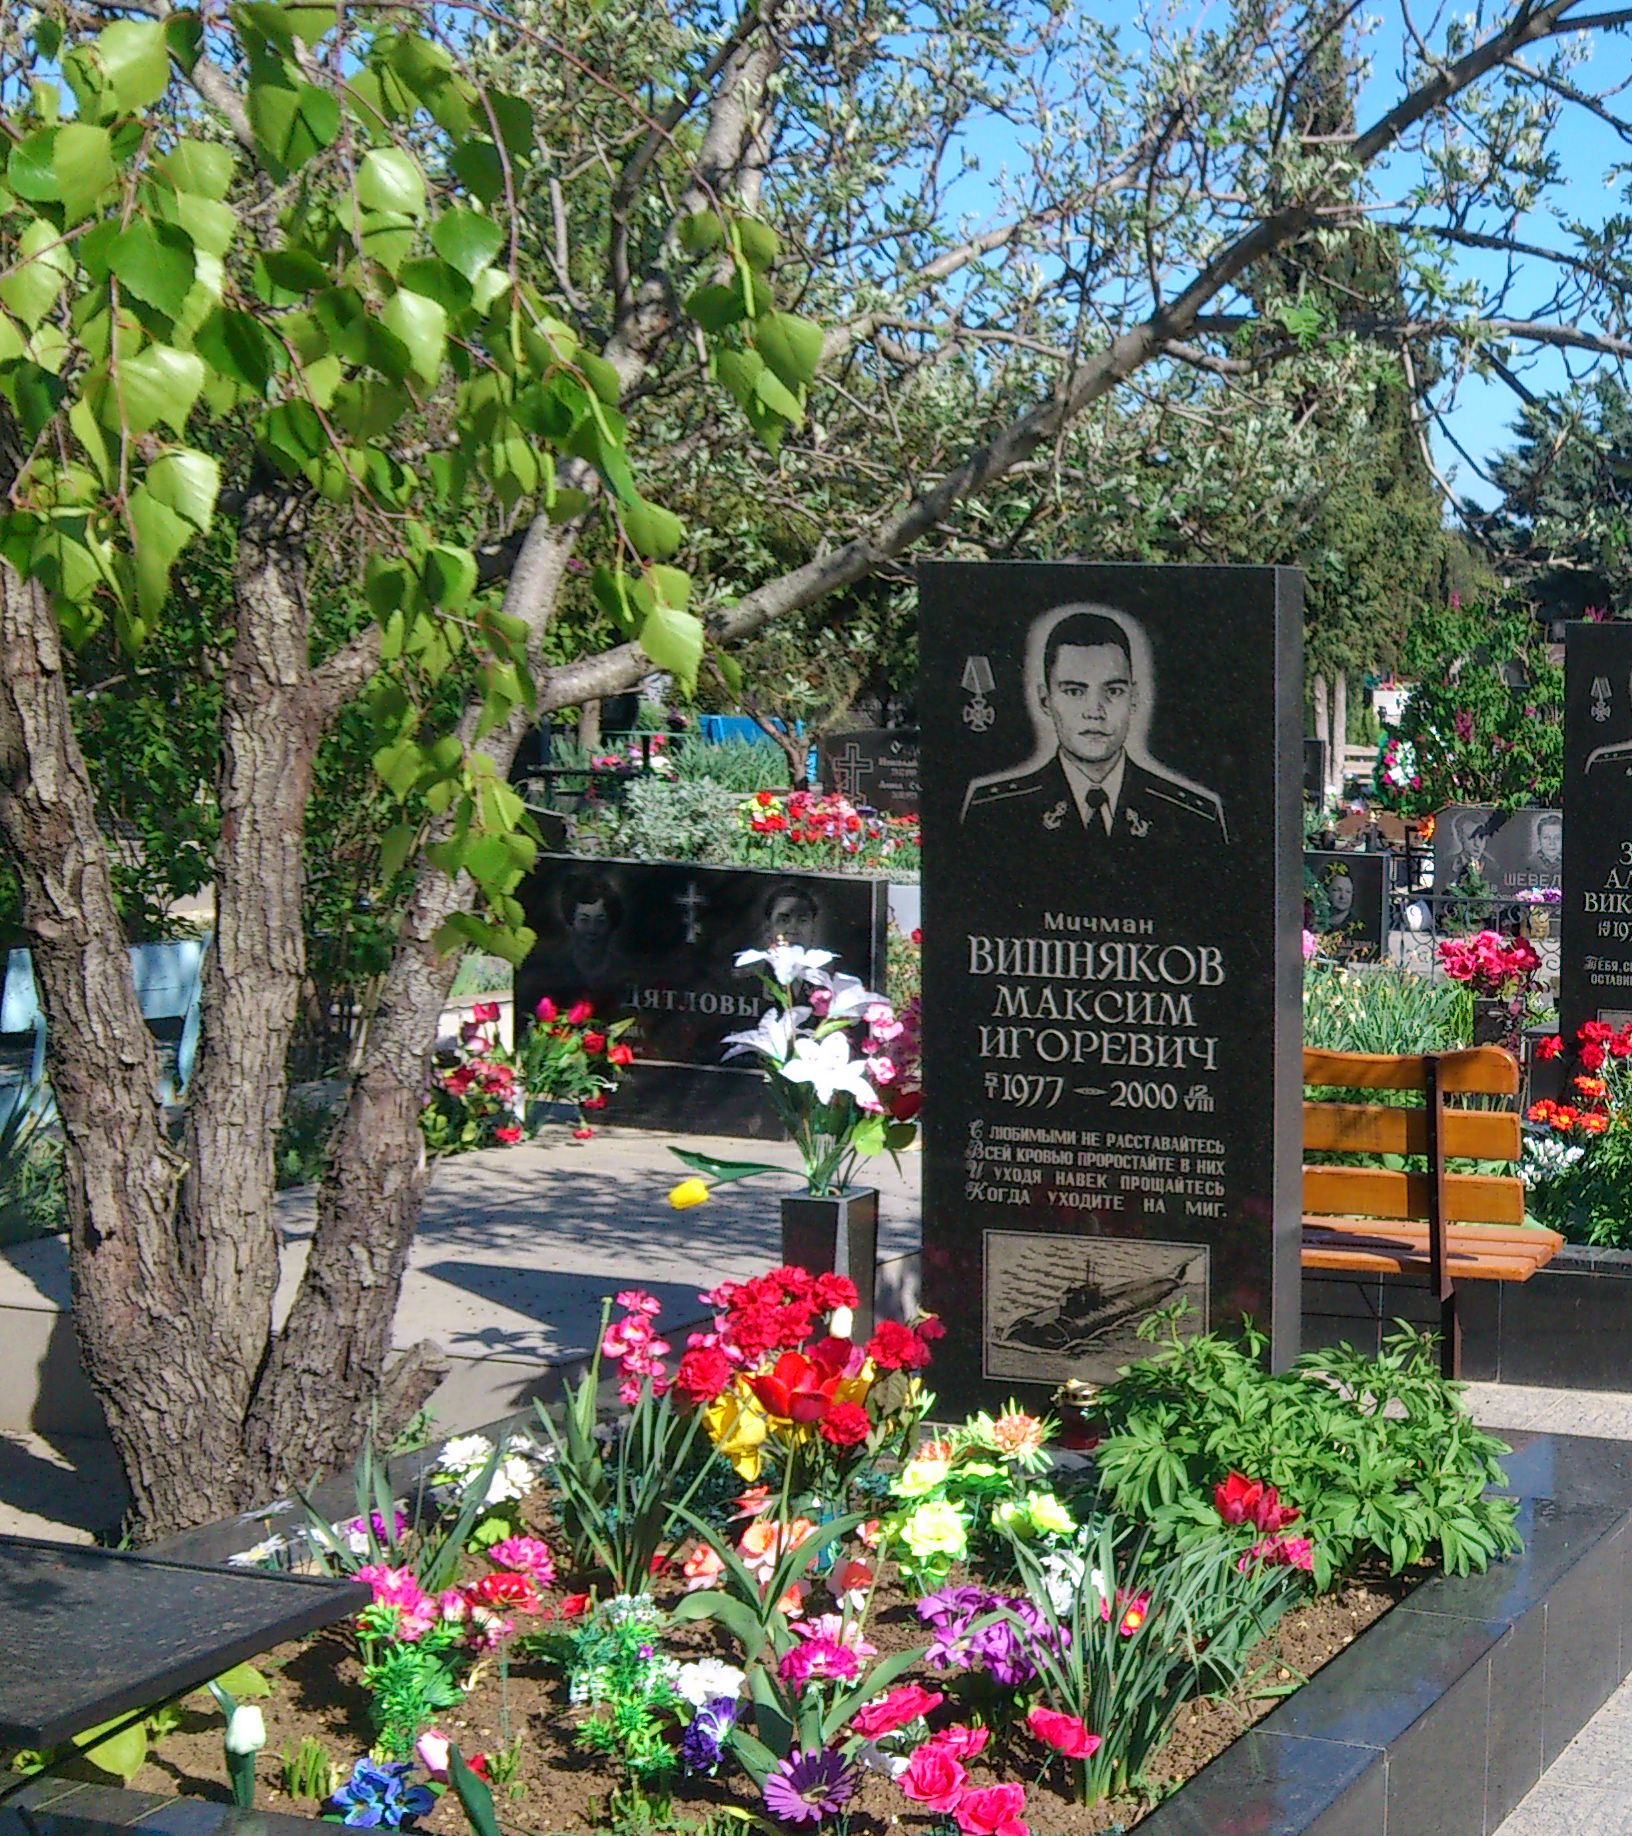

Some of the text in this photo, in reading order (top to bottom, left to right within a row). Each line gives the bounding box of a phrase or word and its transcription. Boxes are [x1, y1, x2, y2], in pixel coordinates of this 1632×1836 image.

[1504, 872, 1561, 887] ШЕВЕЛ
[1044, 912, 1154, 935] Мичман
[968, 935, 1226, 986] ВИШНЯКОВ
[621, 984, 760, 1018] ДЯТЛОВЫ
[992, 985, 1197, 1027] МАКСИМ
[979, 1025, 1219, 1070] ИГОРЕВИЧ
[1002, 1074, 1064, 1108] 1977
[1110, 1081, 1178, 1110] 2000
[966, 1140, 1226, 1176] ВСЕЙ КРОВЬЮ ПРОРОСТАЙТЕ В НИХ
[989, 1126, 1077, 1145] ЛЮБИМЫМИ
[1081, 1131, 1101, 1147] НЕ
[1106, 1133, 1226, 1154] РАССТАВАЙТЕСЬ
[965, 1181, 1228, 1218] КОГДА УХОДИТЕ НА МИГ.
[993, 1166, 1042, 1185] УХОДЯ
[1055, 1170, 1108, 1188] НАВЕК
[1120, 1175, 1226, 1197] ПРОЩАЙТЕСЬ
